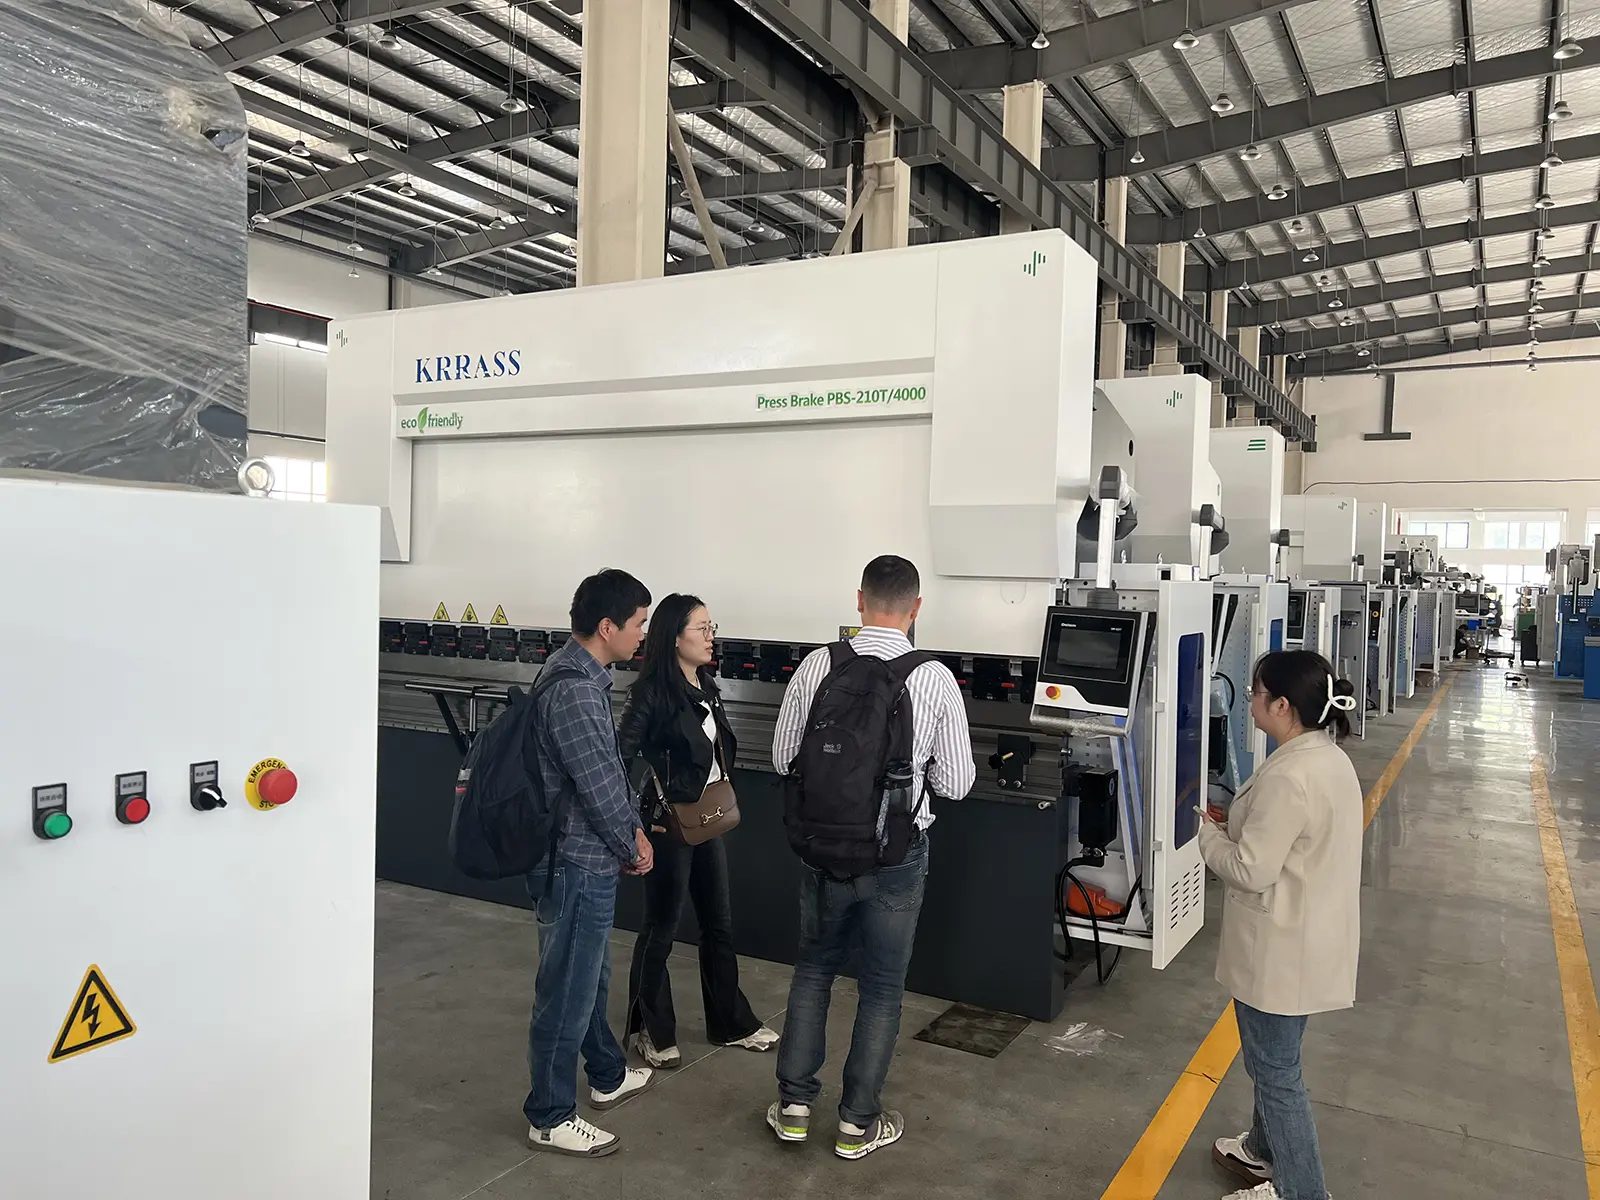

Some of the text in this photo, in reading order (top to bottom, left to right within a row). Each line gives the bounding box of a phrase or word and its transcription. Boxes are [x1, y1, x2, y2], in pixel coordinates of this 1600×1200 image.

[415, 350, 521, 383] KRRASS
[757, 386, 926, 409] Press Brake PBS-210T/4000
[401, 412, 463, 430] eco friendly
[248, 760, 286, 784] EMERGEN
[259, 800, 274, 809] STO
